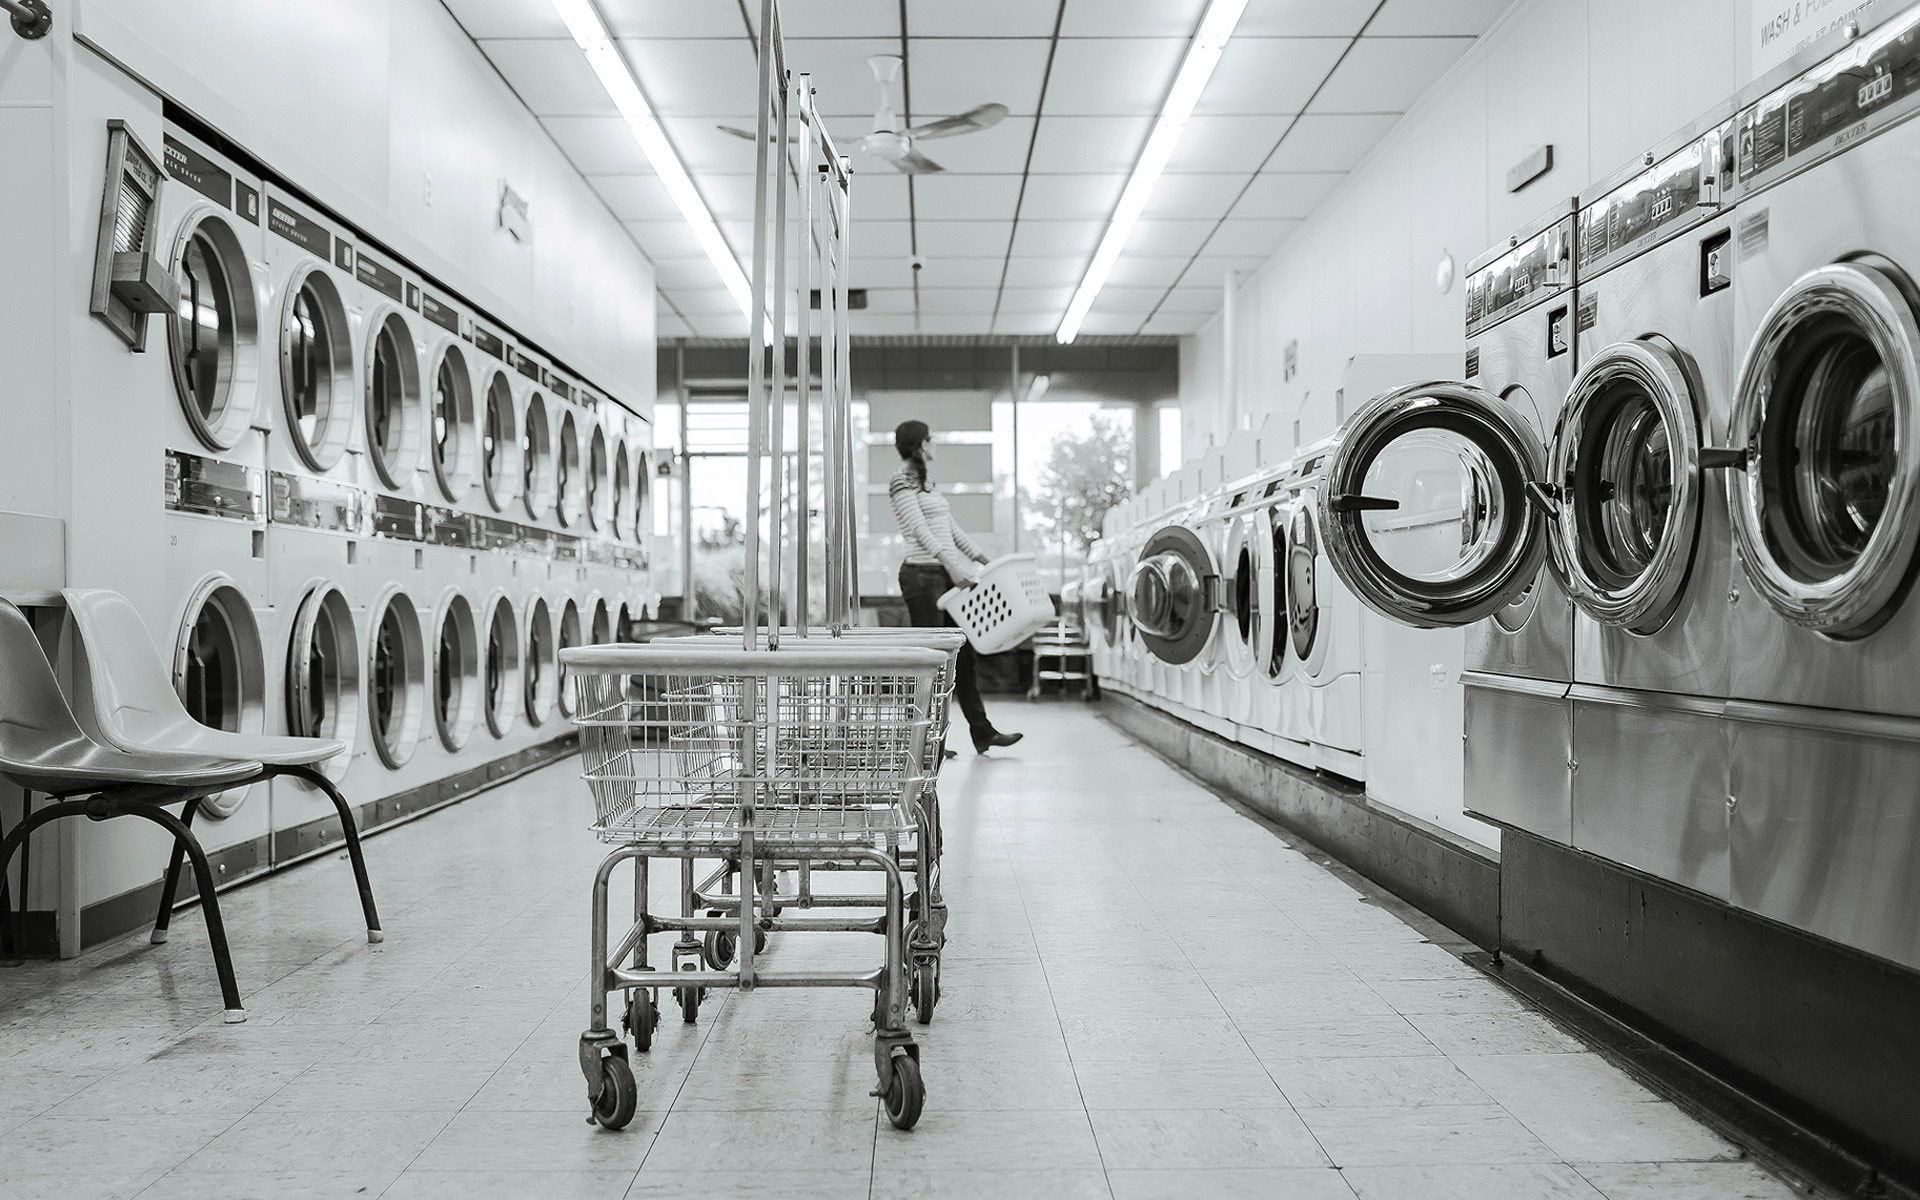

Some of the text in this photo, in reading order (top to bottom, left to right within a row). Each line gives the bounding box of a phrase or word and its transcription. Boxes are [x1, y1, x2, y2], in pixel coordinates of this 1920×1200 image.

[1761, 8, 1791, 48] WASH
[1793, 2, 1801, 26] &
[1834, 121, 1867, 146] DEXTER
[163, 143, 188, 164] EXTER
[170, 534, 178, 547] 20
